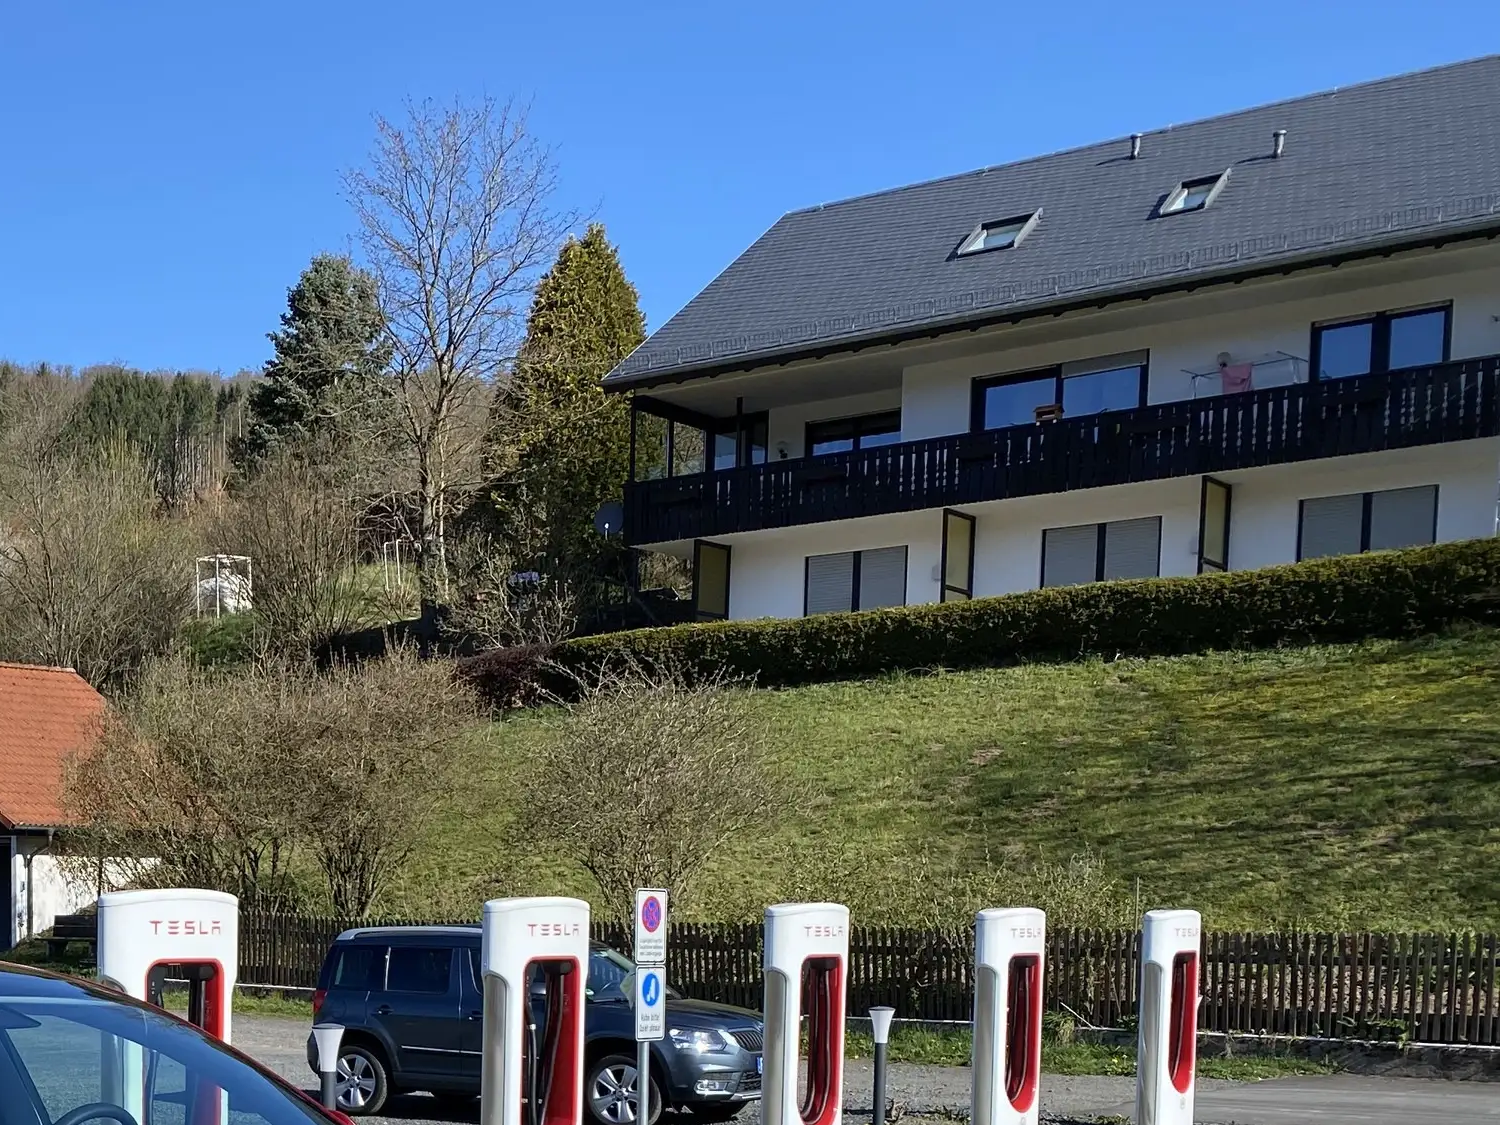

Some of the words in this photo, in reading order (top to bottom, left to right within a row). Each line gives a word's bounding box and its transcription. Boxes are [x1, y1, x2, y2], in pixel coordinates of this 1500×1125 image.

[149, 920, 221, 935] TESLA
[527, 924, 579, 936] TESLA
[804, 926, 843, 937] TESLA
[1010, 928, 1041, 938] TESLA
